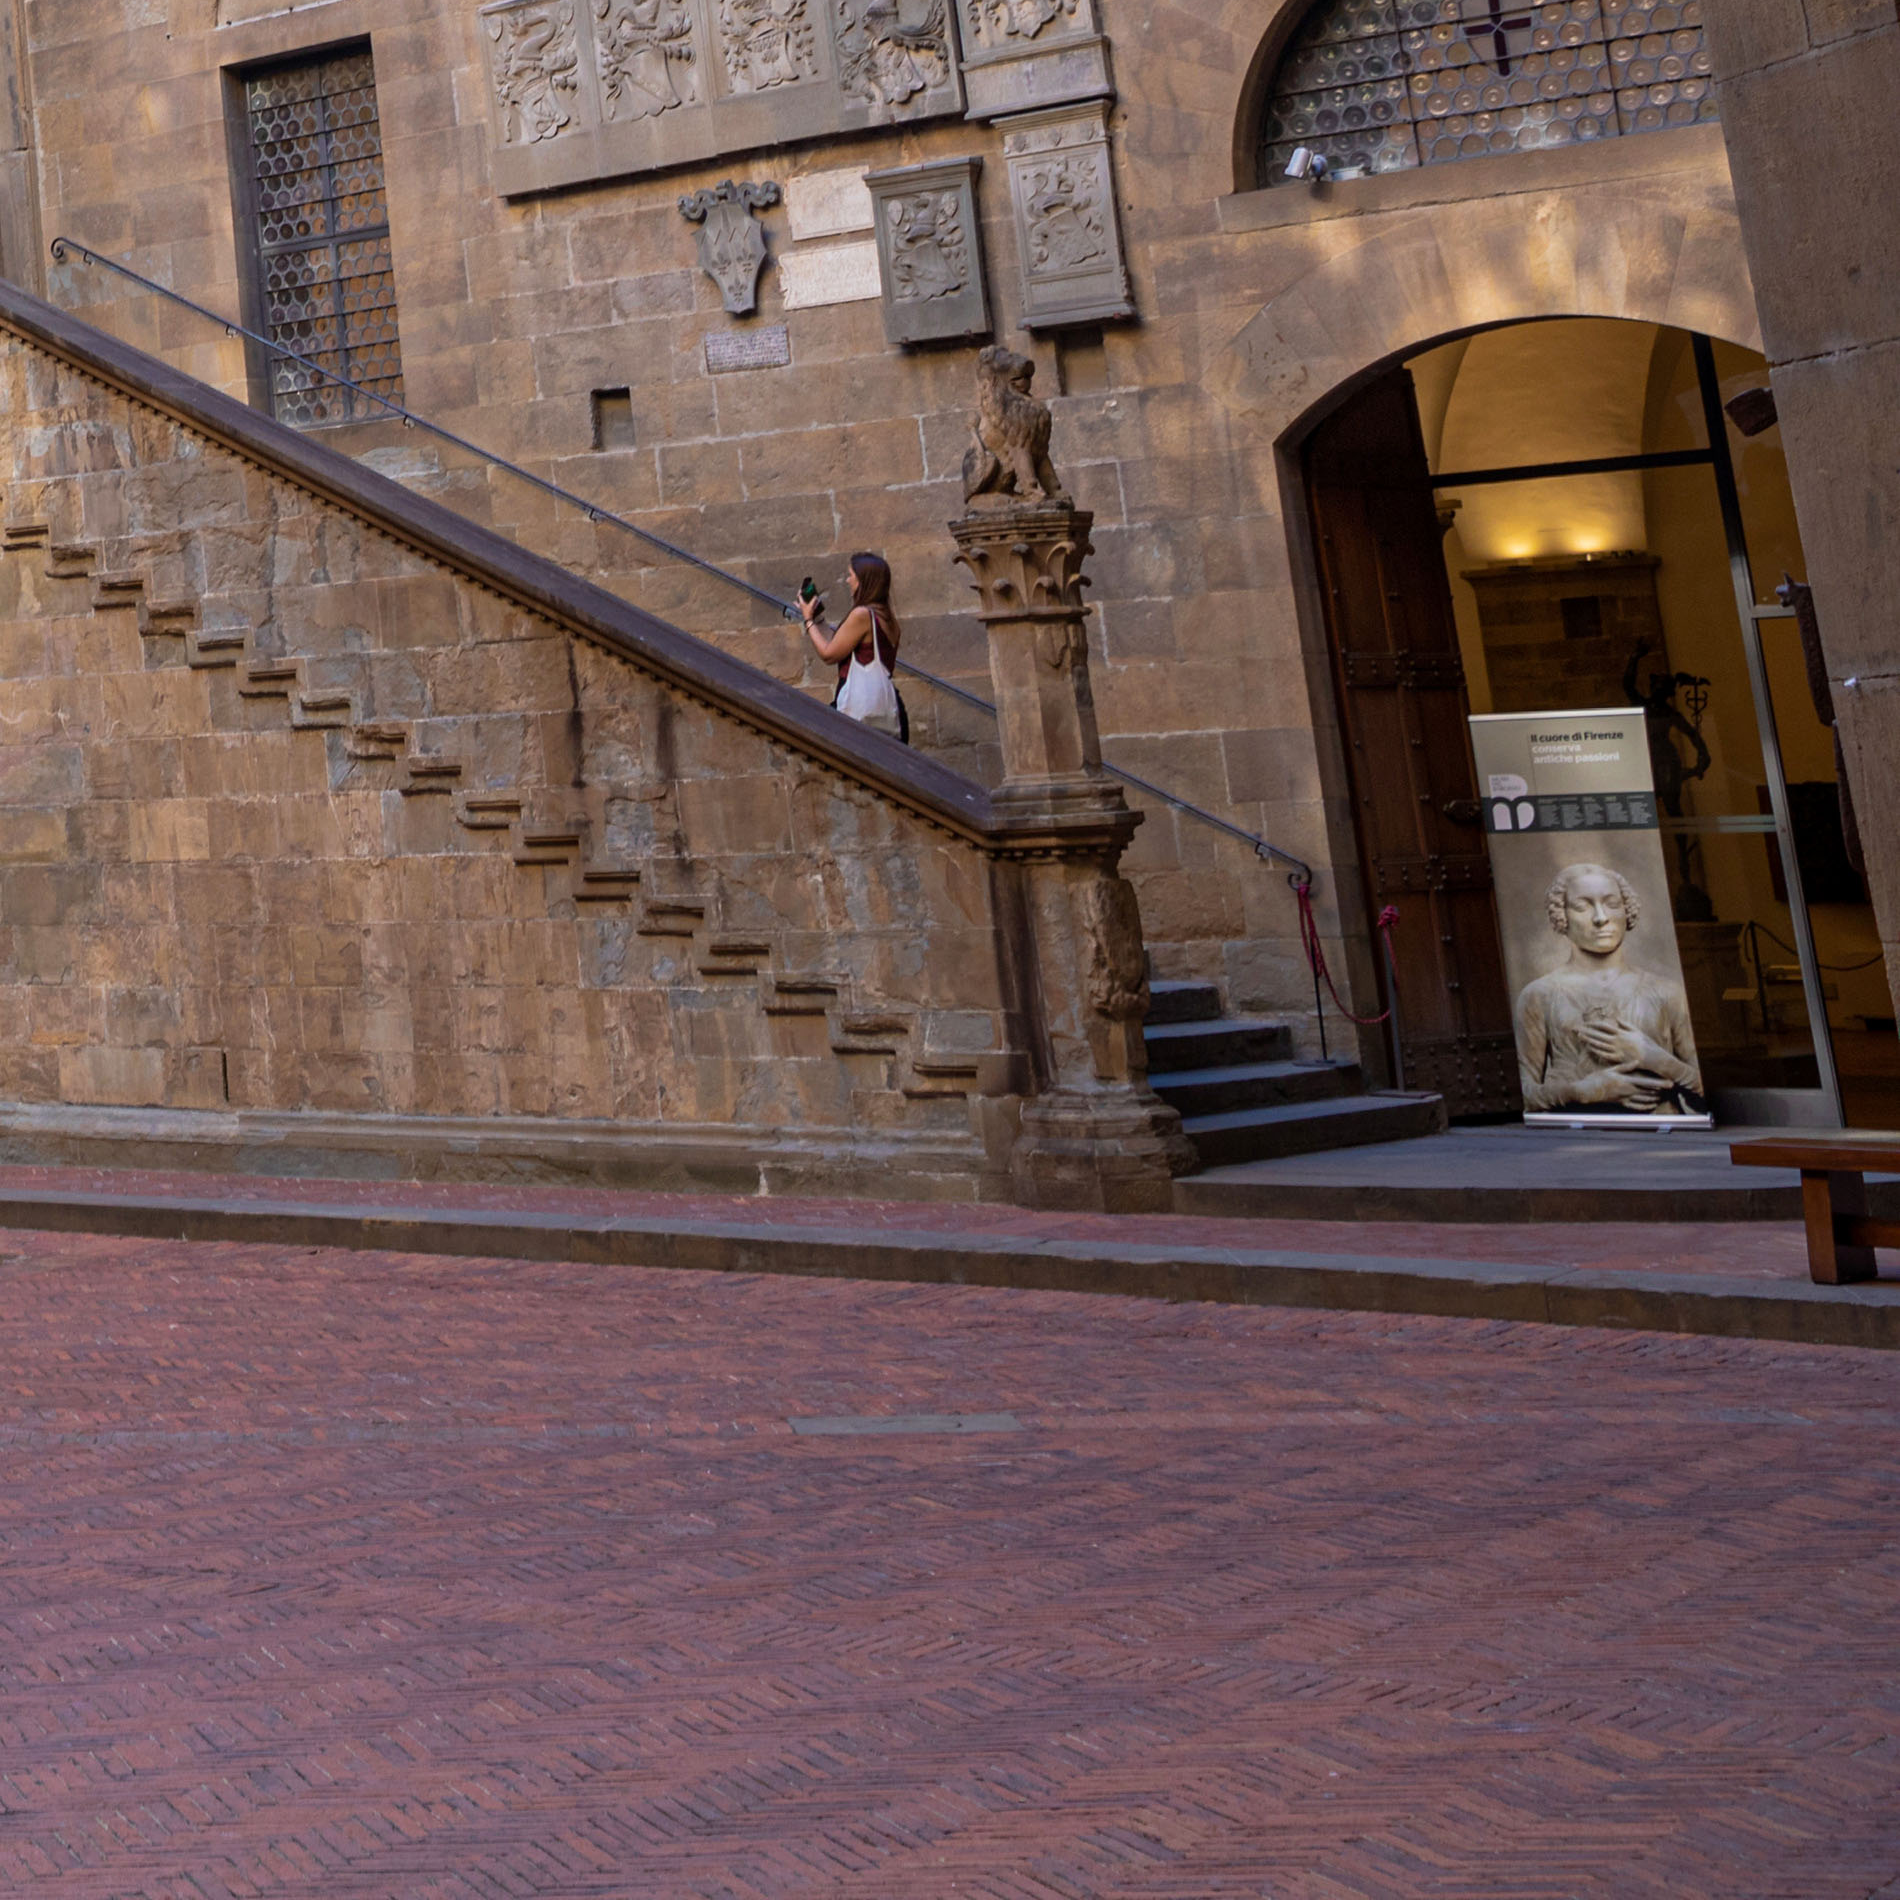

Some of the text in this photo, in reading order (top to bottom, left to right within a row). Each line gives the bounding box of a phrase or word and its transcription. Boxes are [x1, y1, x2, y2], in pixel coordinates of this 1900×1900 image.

[1530, 731, 1624, 742] Il cuore di Firenze
[1532, 744, 1581, 754] conserva
[1533, 751, 1620, 764] antiche passioni
